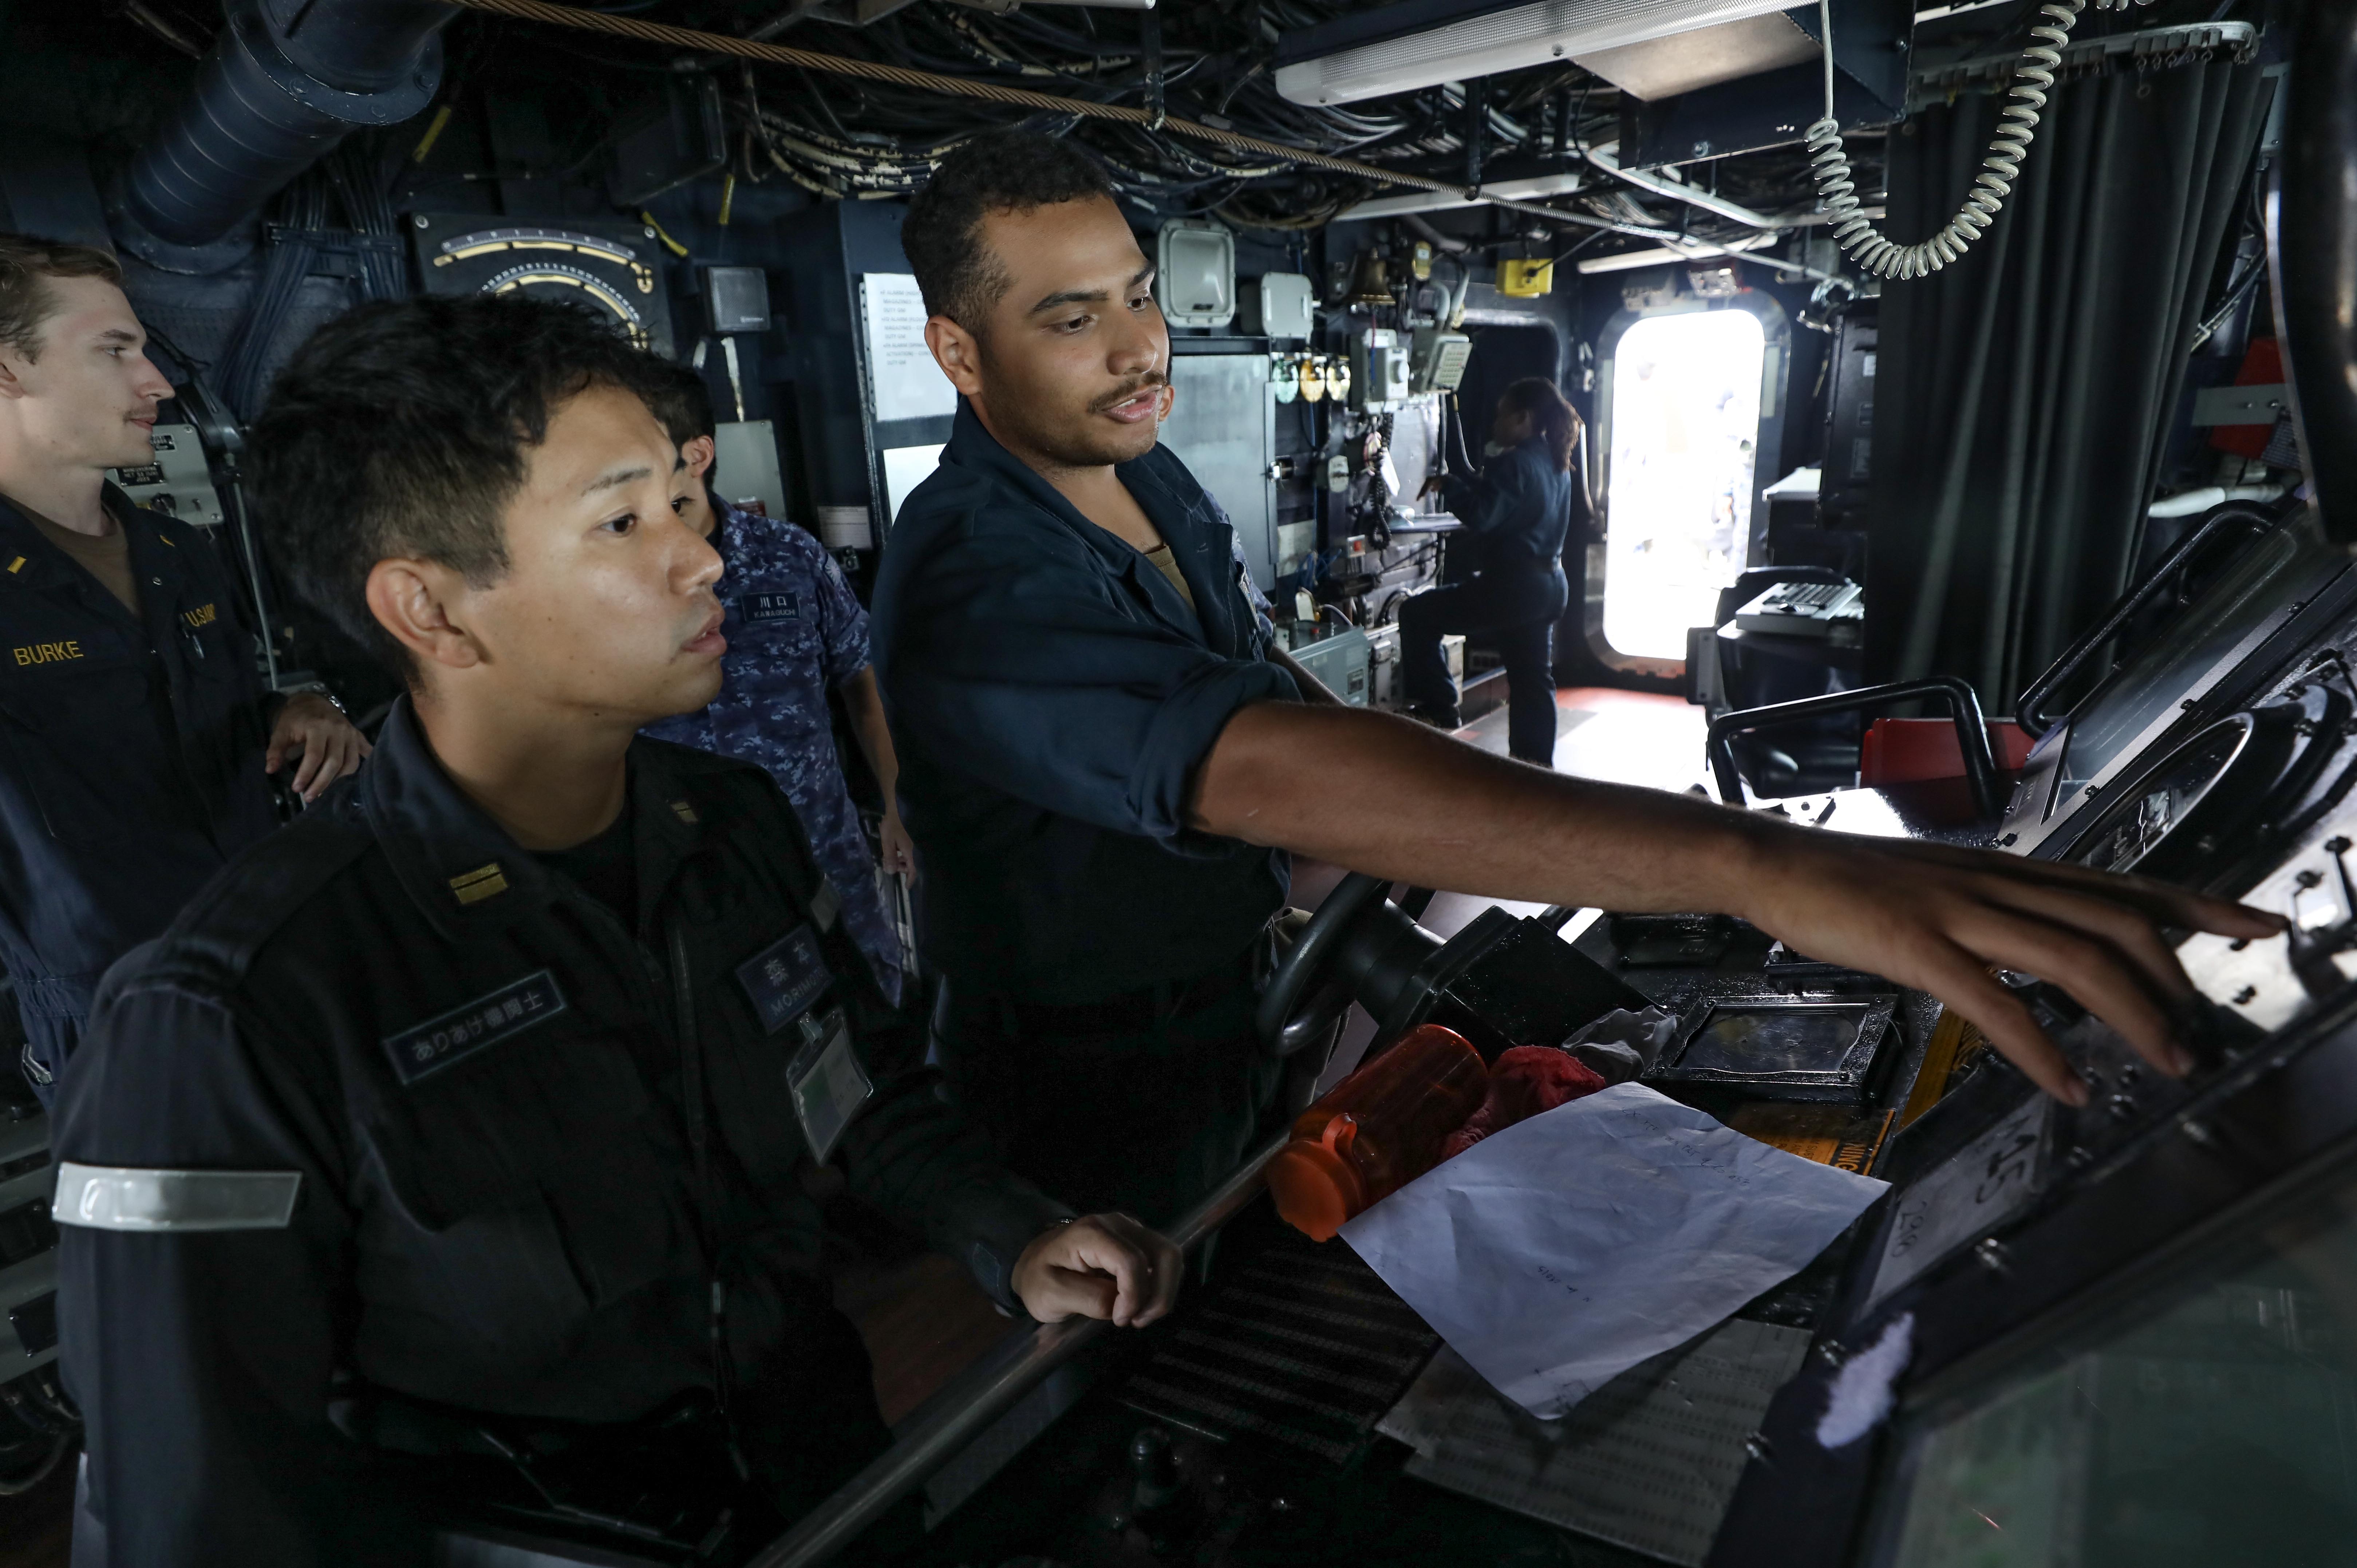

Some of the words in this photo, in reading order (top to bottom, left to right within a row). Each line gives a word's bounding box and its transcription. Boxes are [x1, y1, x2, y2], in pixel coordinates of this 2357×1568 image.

[759, 596, 787, 608] 川口
[754, 609, 795, 618] KAWAGUCHI
[13, 640, 84, 666] BURKE
[1835, 1142, 1867, 1172] NING
